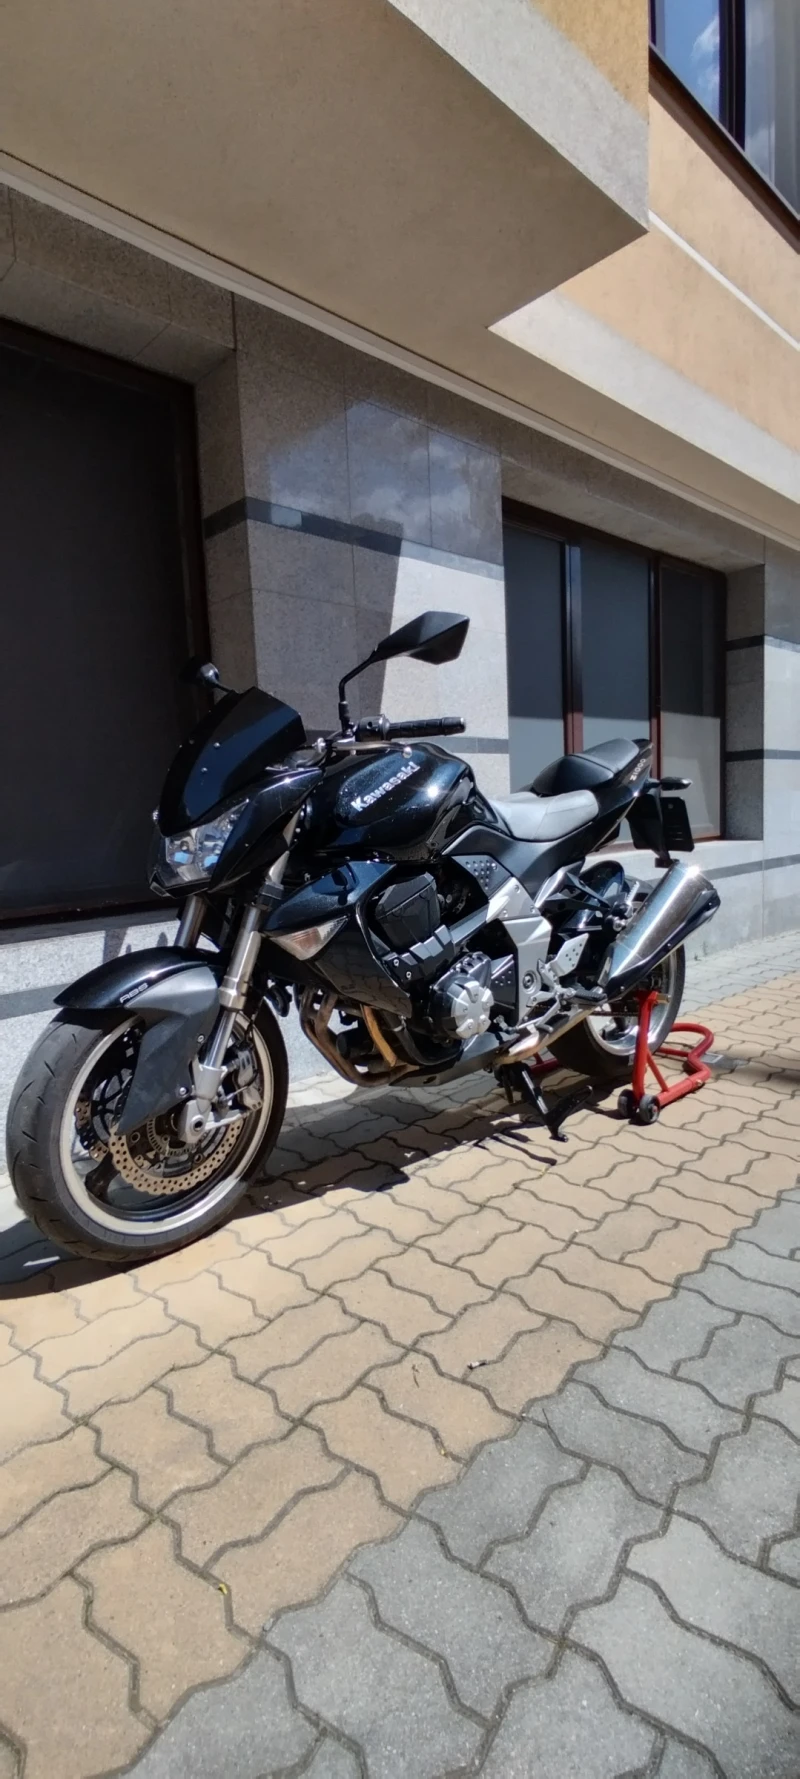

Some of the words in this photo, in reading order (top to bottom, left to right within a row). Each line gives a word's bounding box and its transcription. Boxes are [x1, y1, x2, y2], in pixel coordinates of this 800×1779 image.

[630, 758, 646, 781] Z1000
[350, 761, 420, 812] Kawasaki
[120, 982, 148, 1003] ABS
